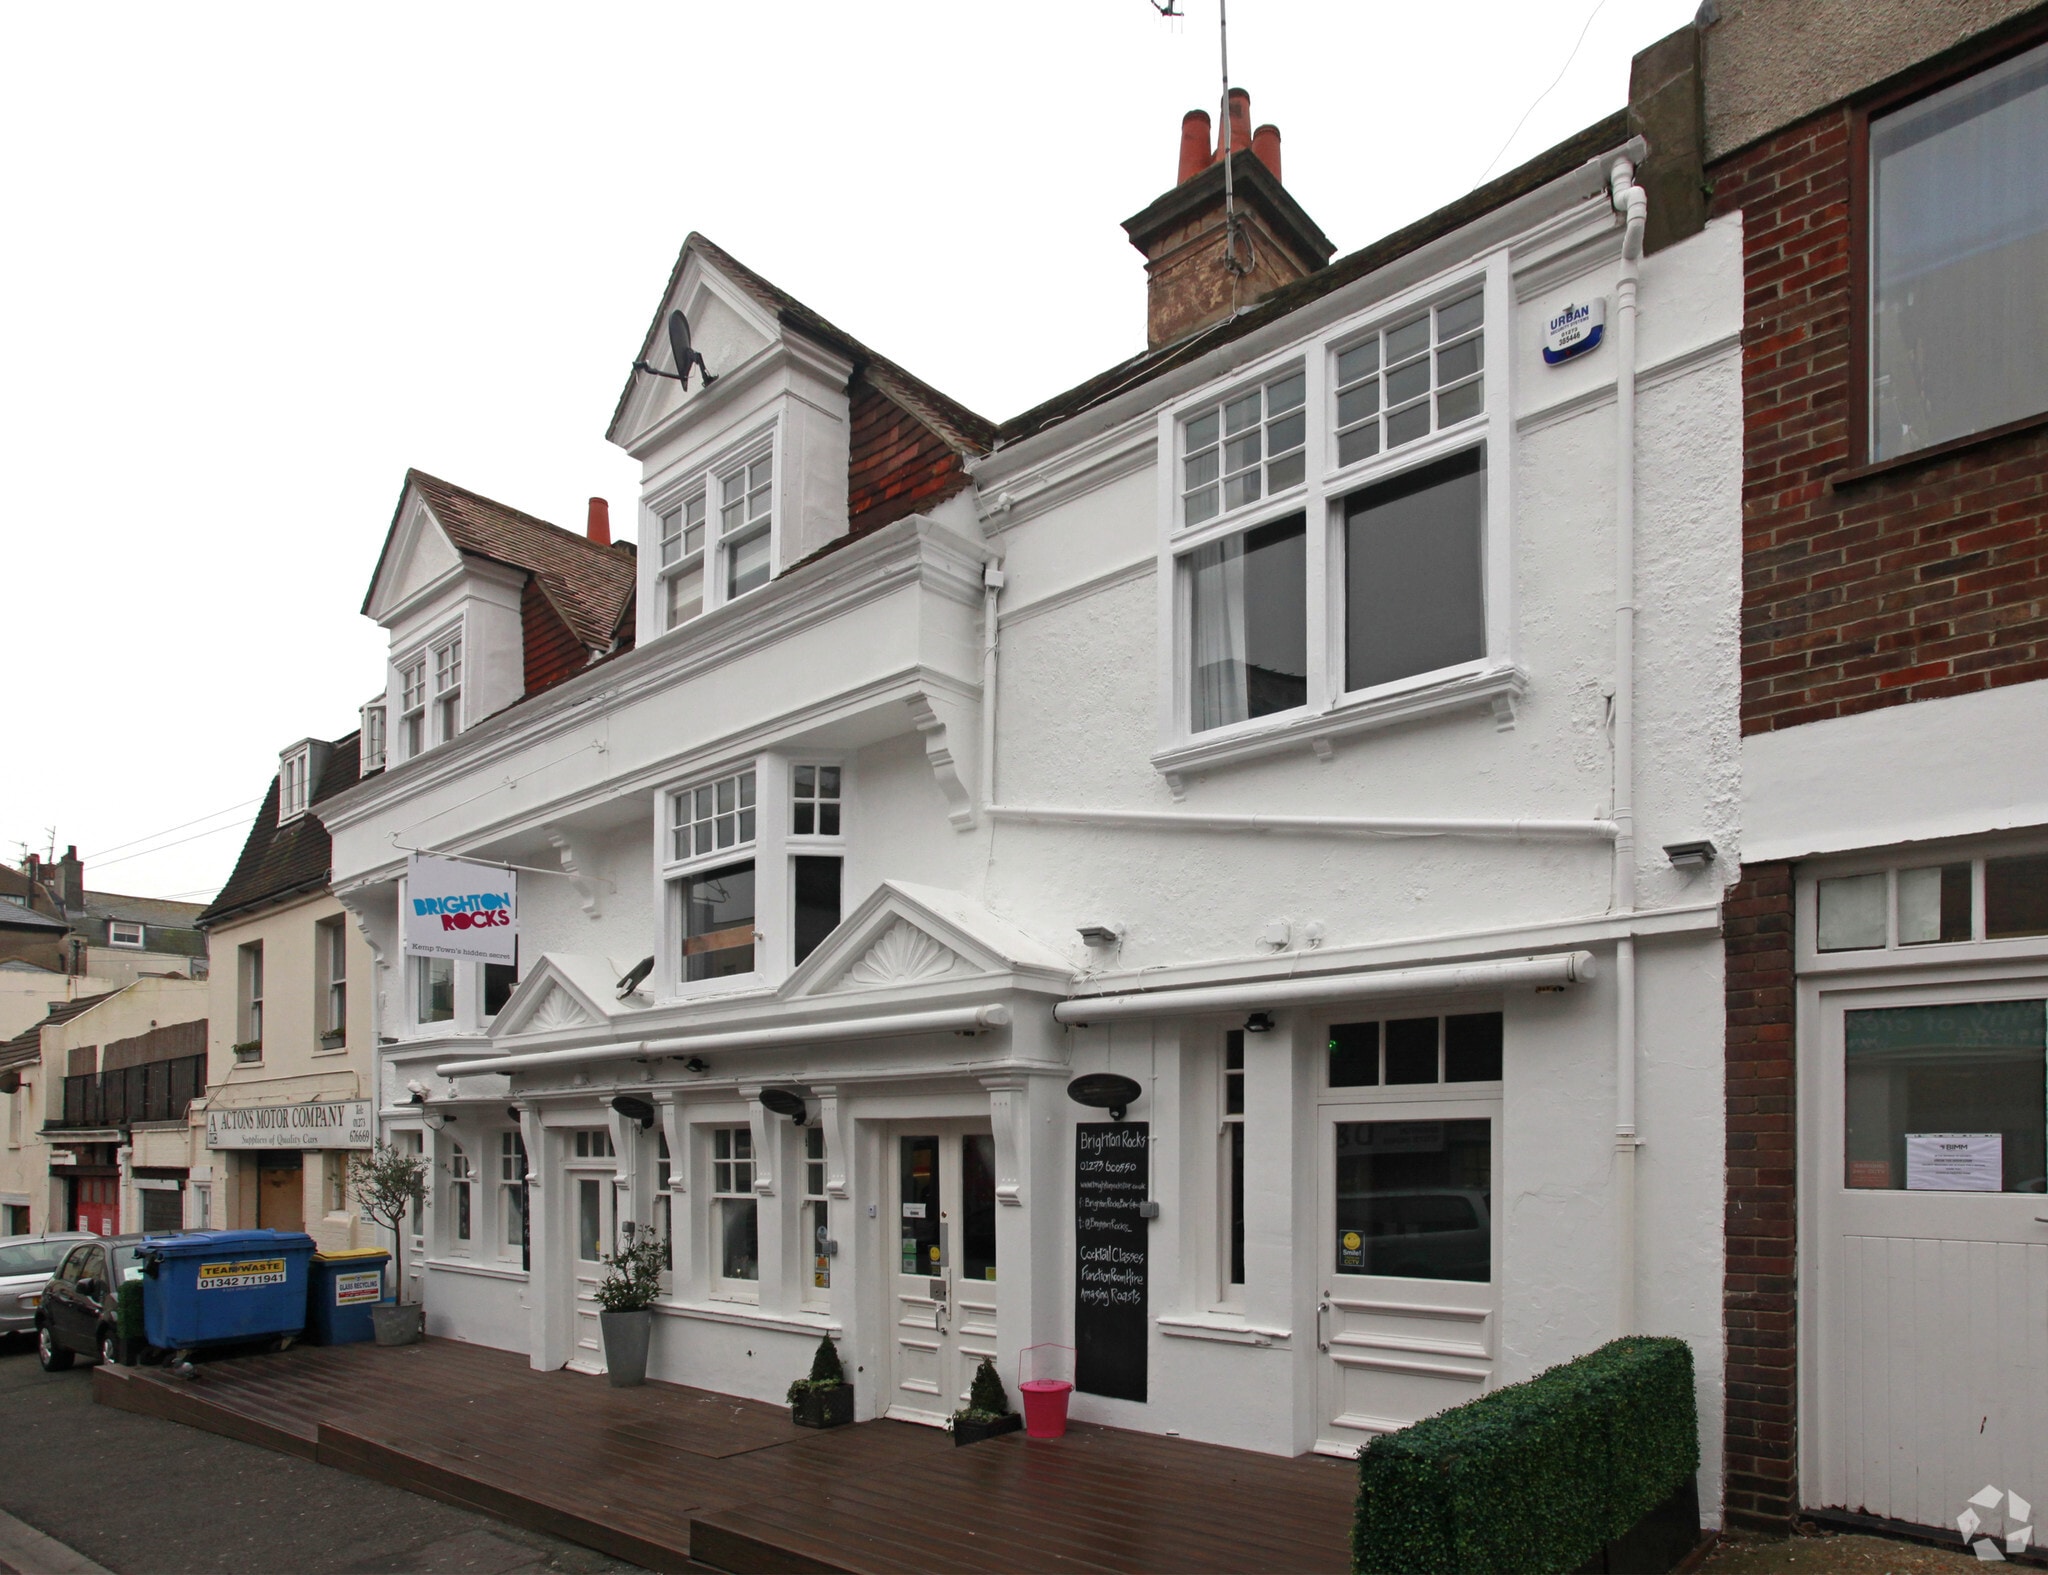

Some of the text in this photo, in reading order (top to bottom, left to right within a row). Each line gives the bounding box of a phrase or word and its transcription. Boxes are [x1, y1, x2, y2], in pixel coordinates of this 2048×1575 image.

[1550, 305, 1589, 330] URBAN
[413, 892, 511, 916] BRIGHTON
[441, 909, 510, 931] ROCKS
[412, 943, 511, 960] Kemp Town's hidden secret
[256, 1108, 289, 1129] MOTOR
[292, 1105, 345, 1128] COMPANY
[353, 1118, 366, 1127] 01273
[242, 1133, 318, 1145] Suppliers of Quality Cars
[350, 1130, 370, 1142] 676669
[1081, 1130, 1146, 1155] Brighton Rocks
[1080, 1161, 1137, 1173] 01273 600550
[1081, 1245, 1144, 1264] Cocktail Classes
[239, 1262, 281, 1272] WASTE
[1081, 1264, 1144, 1286] Function Room Hire
[201, 1277, 239, 1288] 01342
[243, 1274, 284, 1285] 711941
[1111, 1288, 1141, 1305] Roasts
